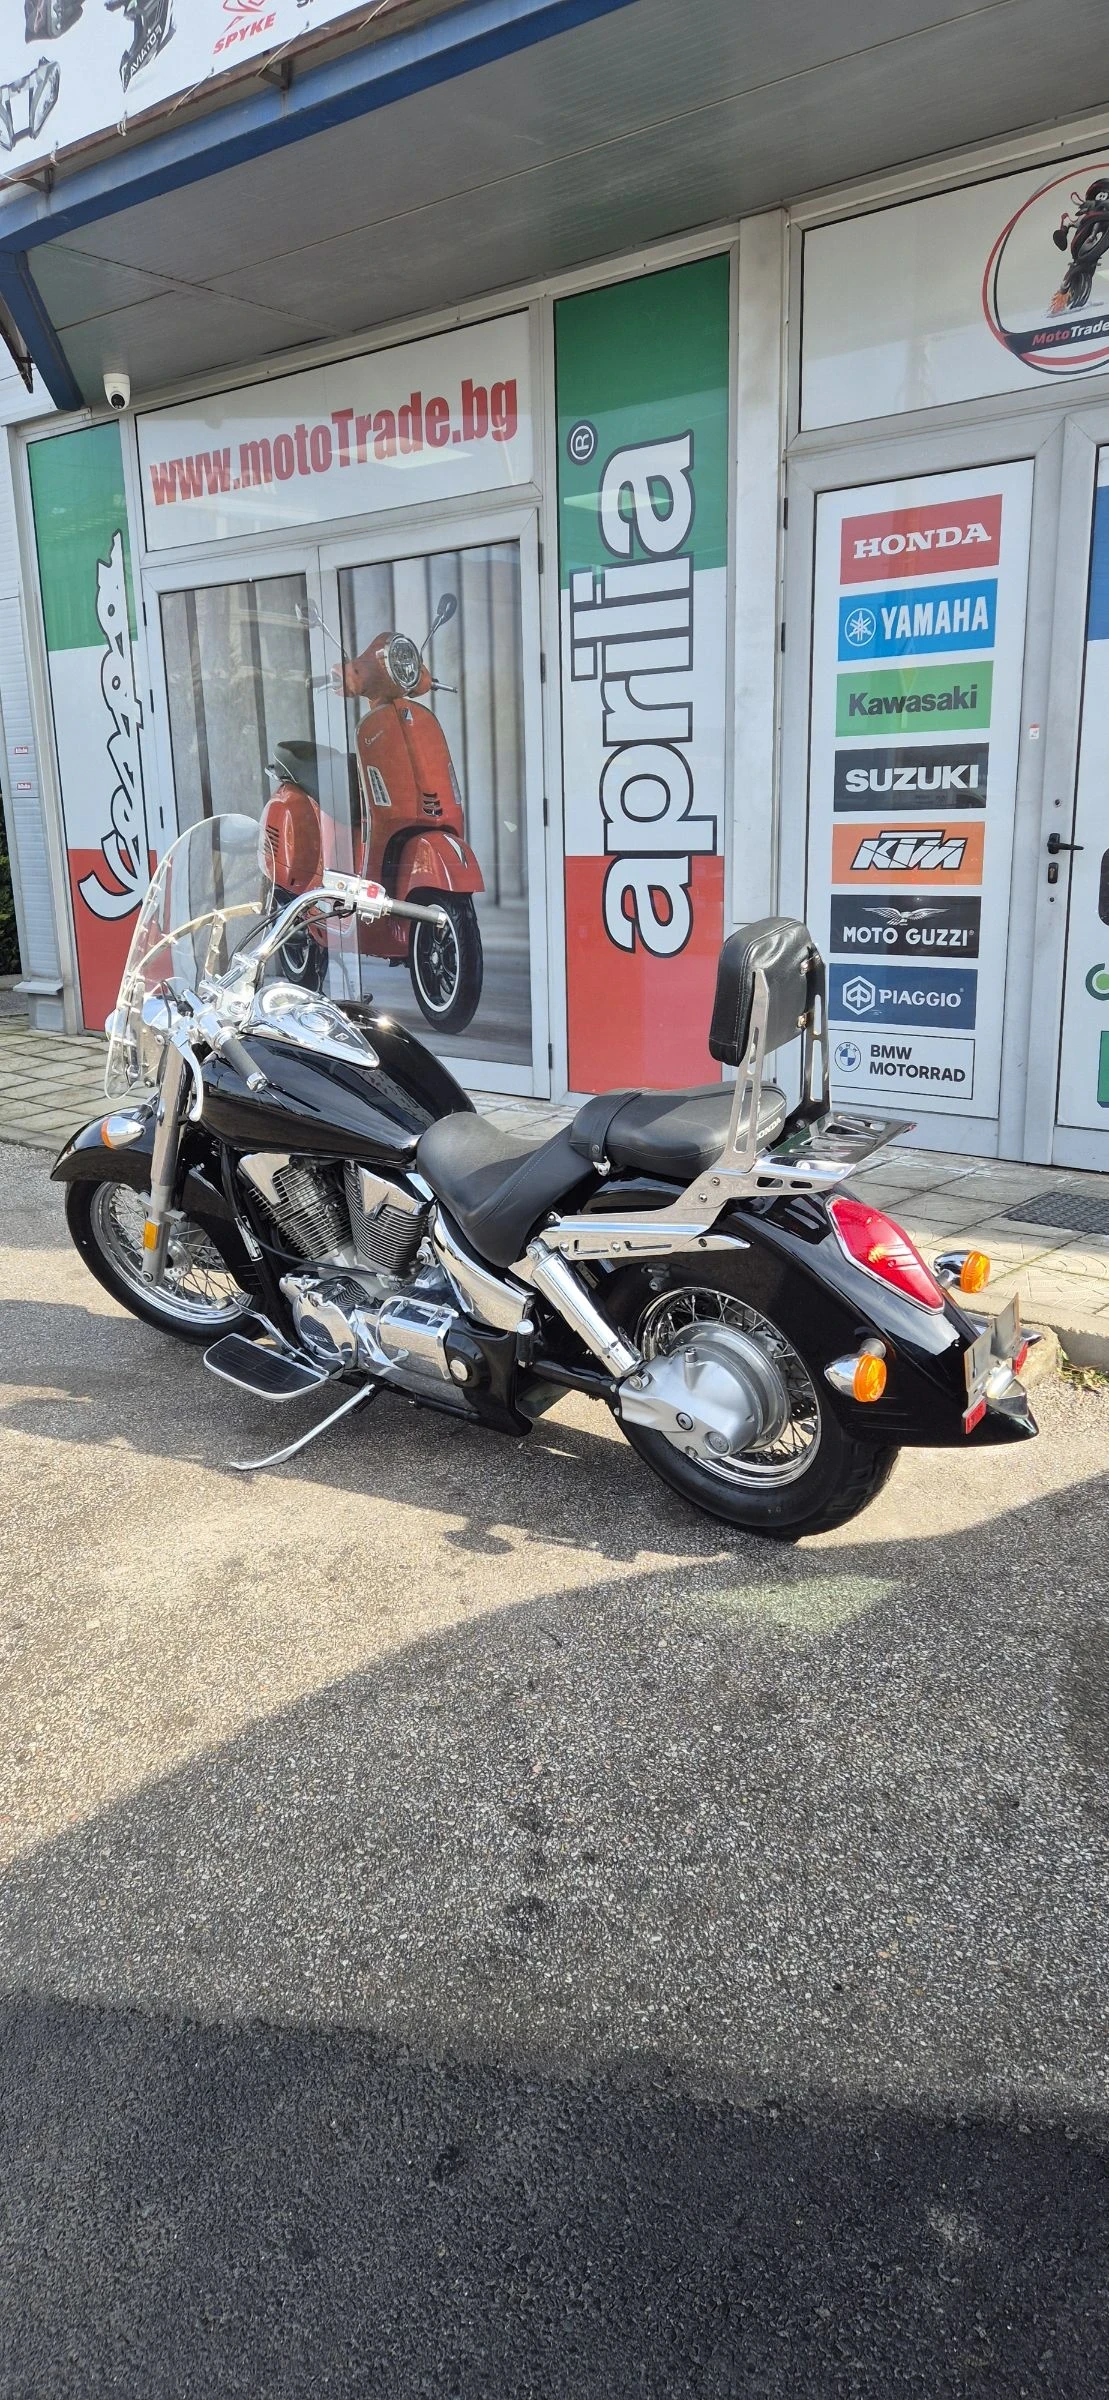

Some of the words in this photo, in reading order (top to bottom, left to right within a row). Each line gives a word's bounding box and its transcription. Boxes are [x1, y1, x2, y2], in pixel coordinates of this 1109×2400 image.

[213, 12, 277, 55] SPYKE
[149, 378, 518, 506] www.motoTrade.bg
[853, 522, 992, 559] HONDA
[881, 596, 989, 640] YAMAHA
[848, 683, 978, 717] Kawasaki
[845, 764, 979, 793] SUZUKI
[850, 829, 968, 870] KTM
[842, 926, 899, 945] MOTO
[870, 1044, 912, 1060] BMW
[869, 1061, 966, 1083] MOTORRAD
